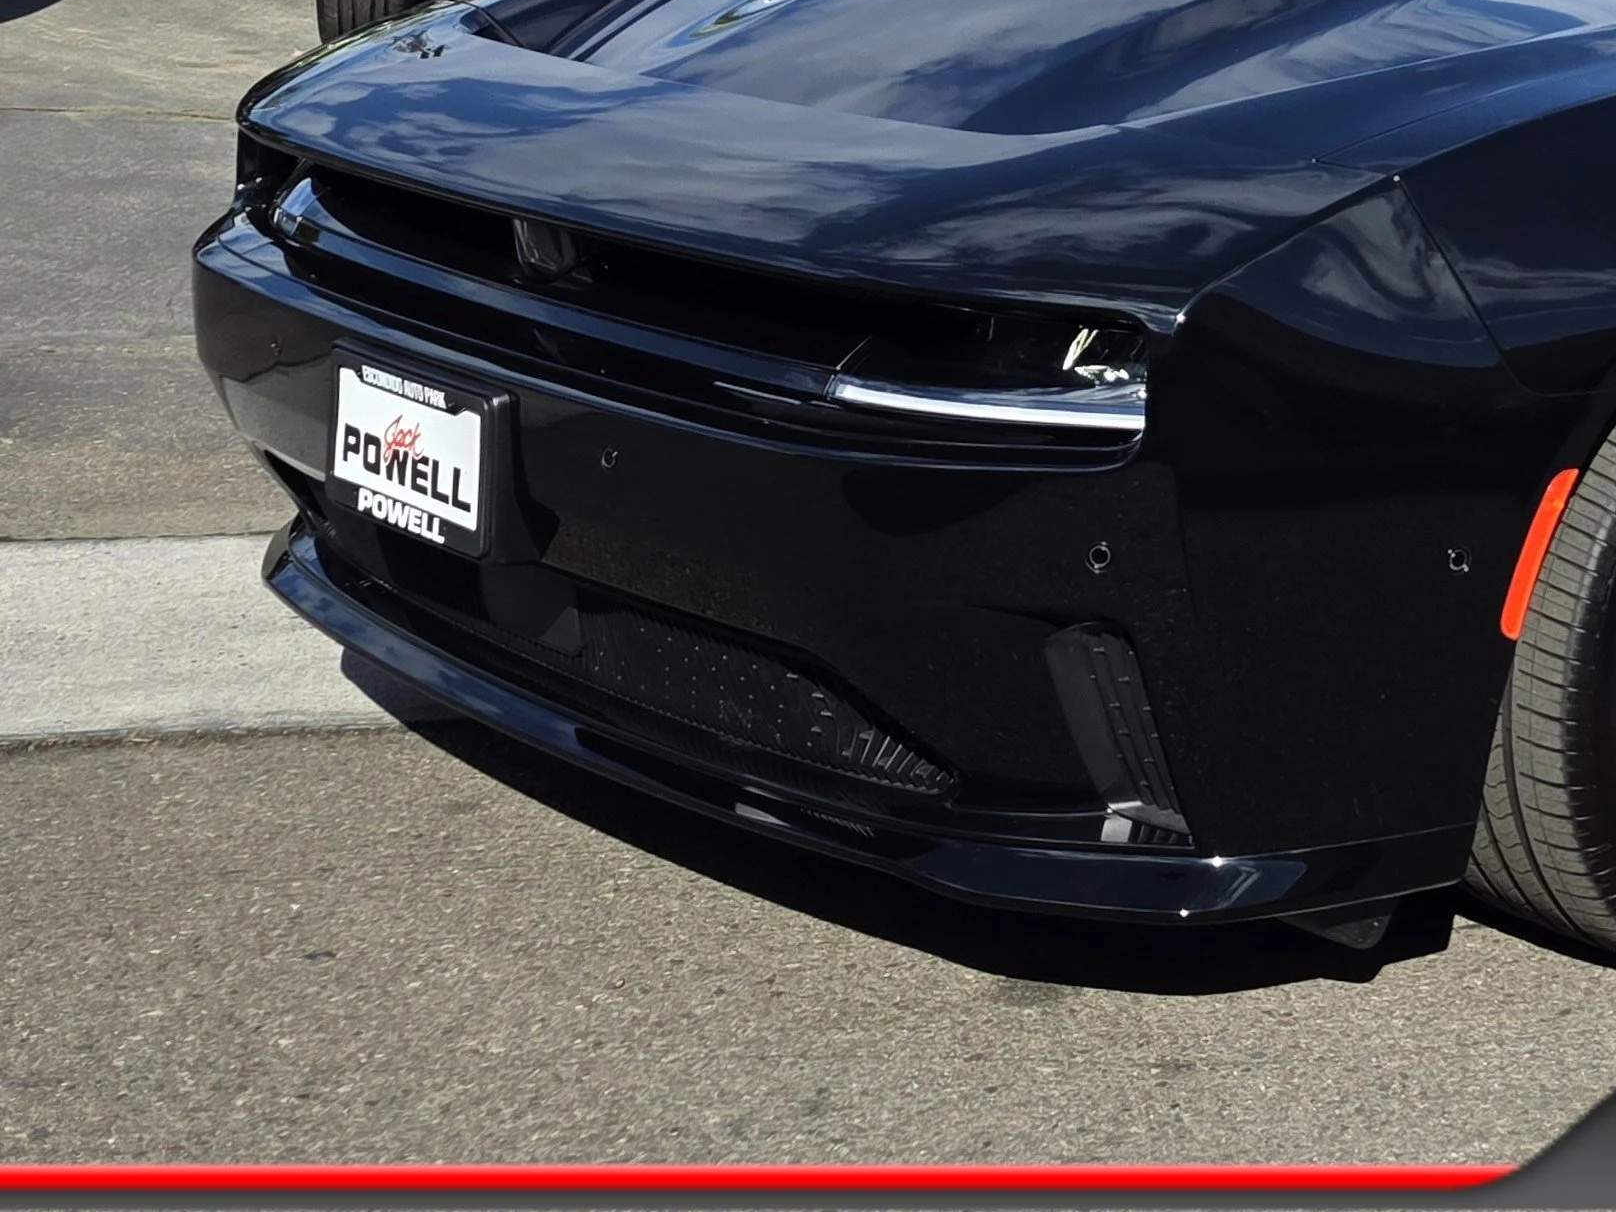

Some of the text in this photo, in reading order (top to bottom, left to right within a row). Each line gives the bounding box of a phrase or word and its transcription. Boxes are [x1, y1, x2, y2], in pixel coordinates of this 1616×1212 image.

[382, 414, 425, 463] Jack
[342, 422, 472, 514] POWELL
[357, 487, 446, 545] POWELL
